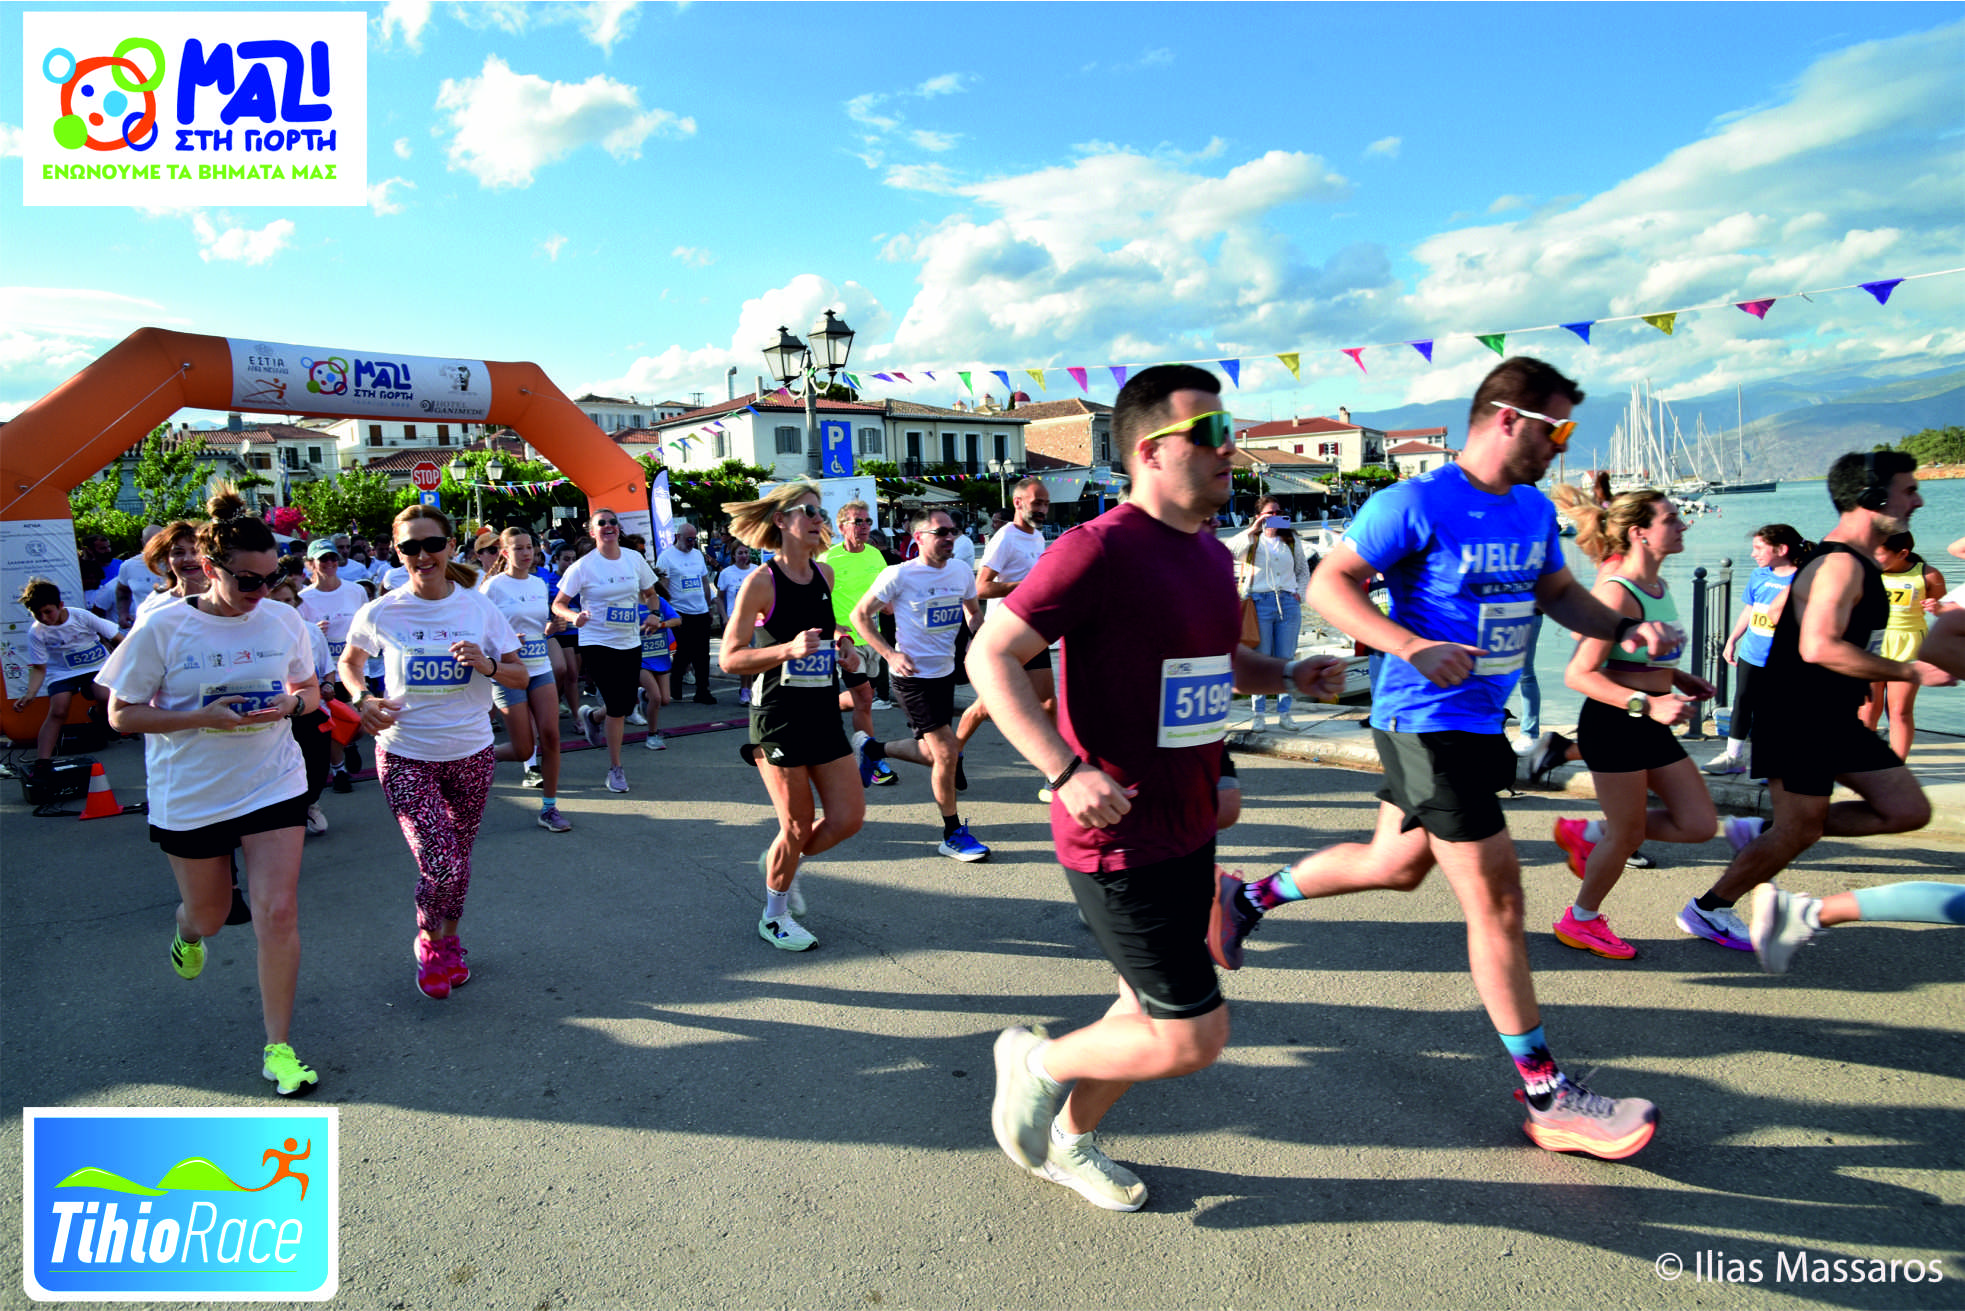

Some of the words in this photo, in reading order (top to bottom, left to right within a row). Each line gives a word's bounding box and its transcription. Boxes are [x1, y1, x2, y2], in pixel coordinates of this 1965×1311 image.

[353, 389, 376, 398] ΣΤΗ
[379, 390, 413, 400] ΓΙΟΡΤΗ
[828, 426, 844, 451] P
[414, 470, 440, 485] STOP
[424, 494, 435, 506] P
[1458, 541, 1548, 573] HELLA
[610, 609, 635, 621] 5181
[932, 607, 961, 624] 5077
[1752, 613, 1777, 629] 10
[520, 643, 546, 657] 5223
[643, 640, 666, 651] 5250
[73, 647, 105, 664] 5222
[794, 654, 832, 673] 5231
[412, 661, 465, 681] 5056
[1175, 682, 1231, 719] 5199
